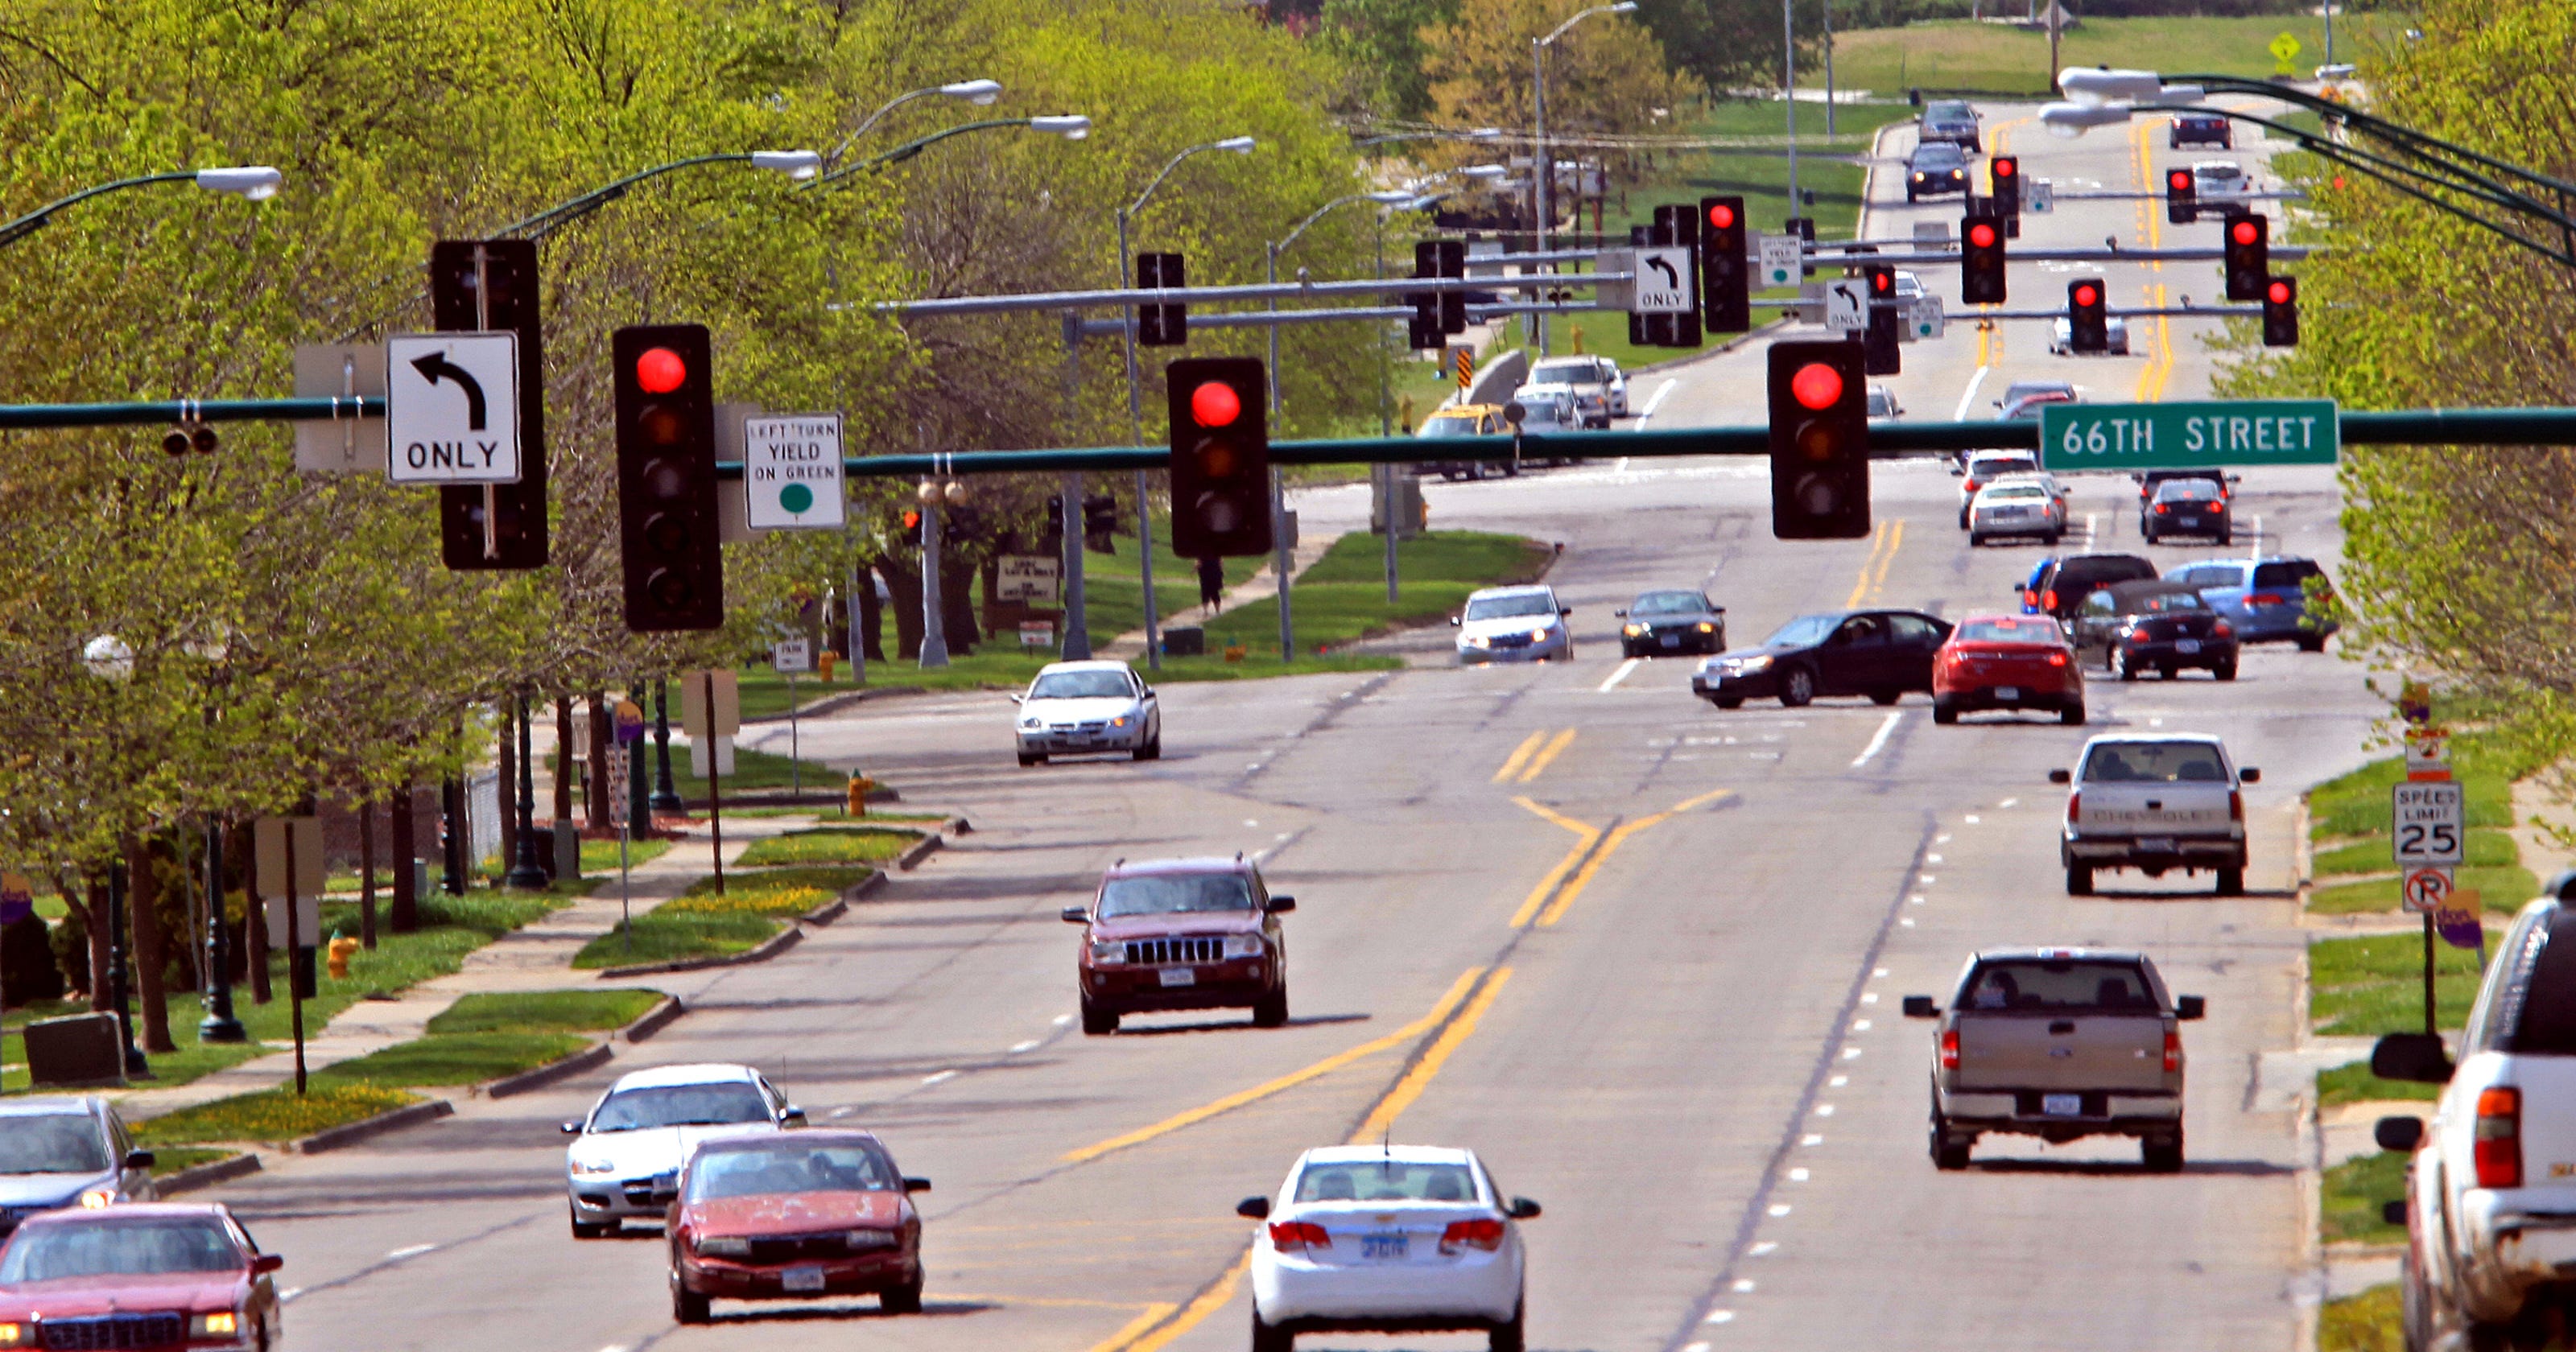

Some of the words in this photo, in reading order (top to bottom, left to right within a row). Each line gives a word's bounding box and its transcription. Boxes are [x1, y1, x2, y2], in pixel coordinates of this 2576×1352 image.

[1642, 292, 1682, 306] ONLY
[749, 423, 786, 438] LEFT
[796, 422, 835, 436] TURN
[2062, 418, 2154, 455] 66TH
[2185, 415, 2317, 452] STREET
[407, 440, 498, 468] ONLY
[769, 442, 819, 460] YIELD
[755, 467, 775, 480] ON
[786, 467, 835, 480] GREEN
[2399, 789, 2456, 804] SPEED
[2404, 807, 2449, 821] LIMIT
[2401, 823, 2456, 854] 25
